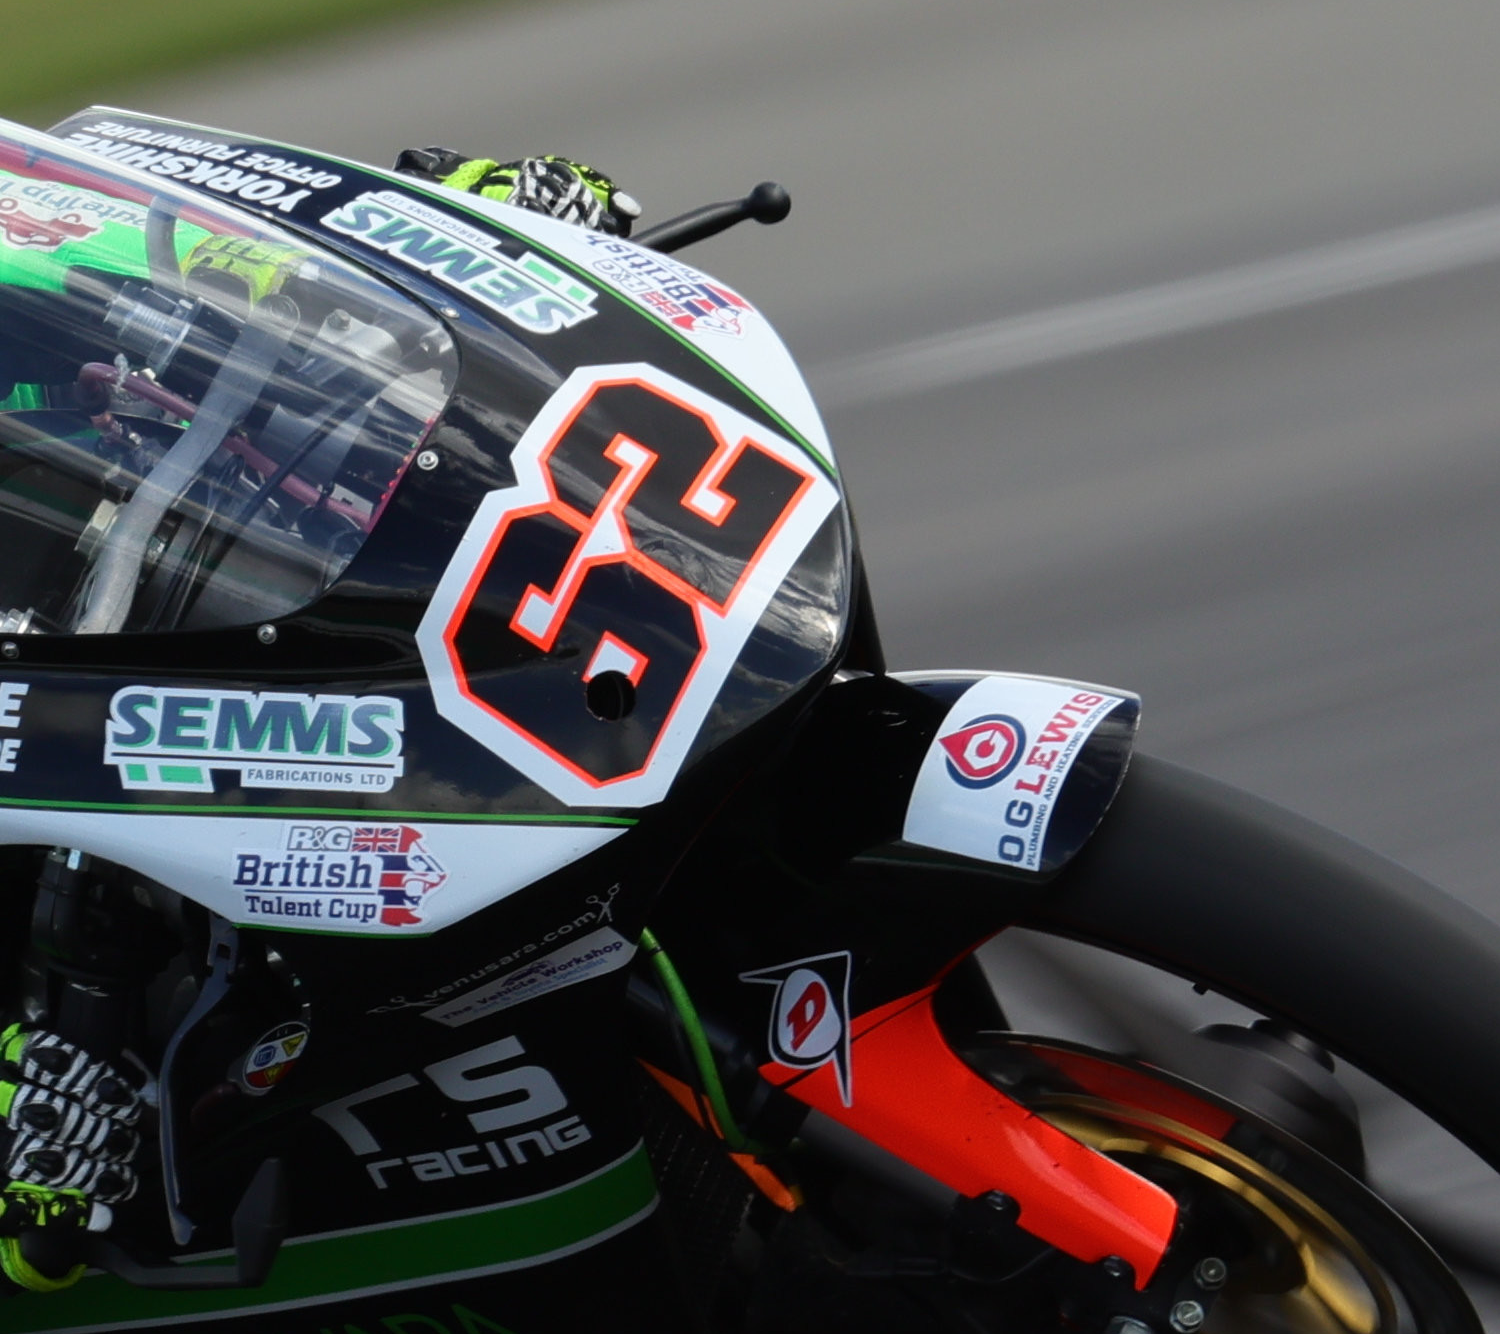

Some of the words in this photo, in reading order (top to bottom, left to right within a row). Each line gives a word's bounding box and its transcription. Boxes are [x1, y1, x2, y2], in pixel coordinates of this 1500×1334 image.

[82, 121, 247, 162] FURNITURE
[64, 133, 312, 212] YORKSHIRE
[233, 152, 343, 189] OFFICE
[381, 193, 406, 209] LTD
[407, 204, 493, 246] FABRICATIONS
[332, 203, 577, 328] SEMMS
[443, 378, 816, 790] 62
[110, 693, 400, 758] SEMMS
[247, 768, 353, 785] FABRICATIONS
[359, 772, 387, 786] LTD
[1027, 804, 1048, 866] PLUMBING
[1043, 777, 1058, 800] AND
[1056, 731, 1084, 774] HEATING
[287, 825, 352, 851] R&G
[233, 854, 372, 889] British
[245, 895, 322, 918] Talent
[329, 898, 377, 923] Cup
[477, 977, 537, 1005] Vehicle
[541, 940, 624, 977] Workshop
